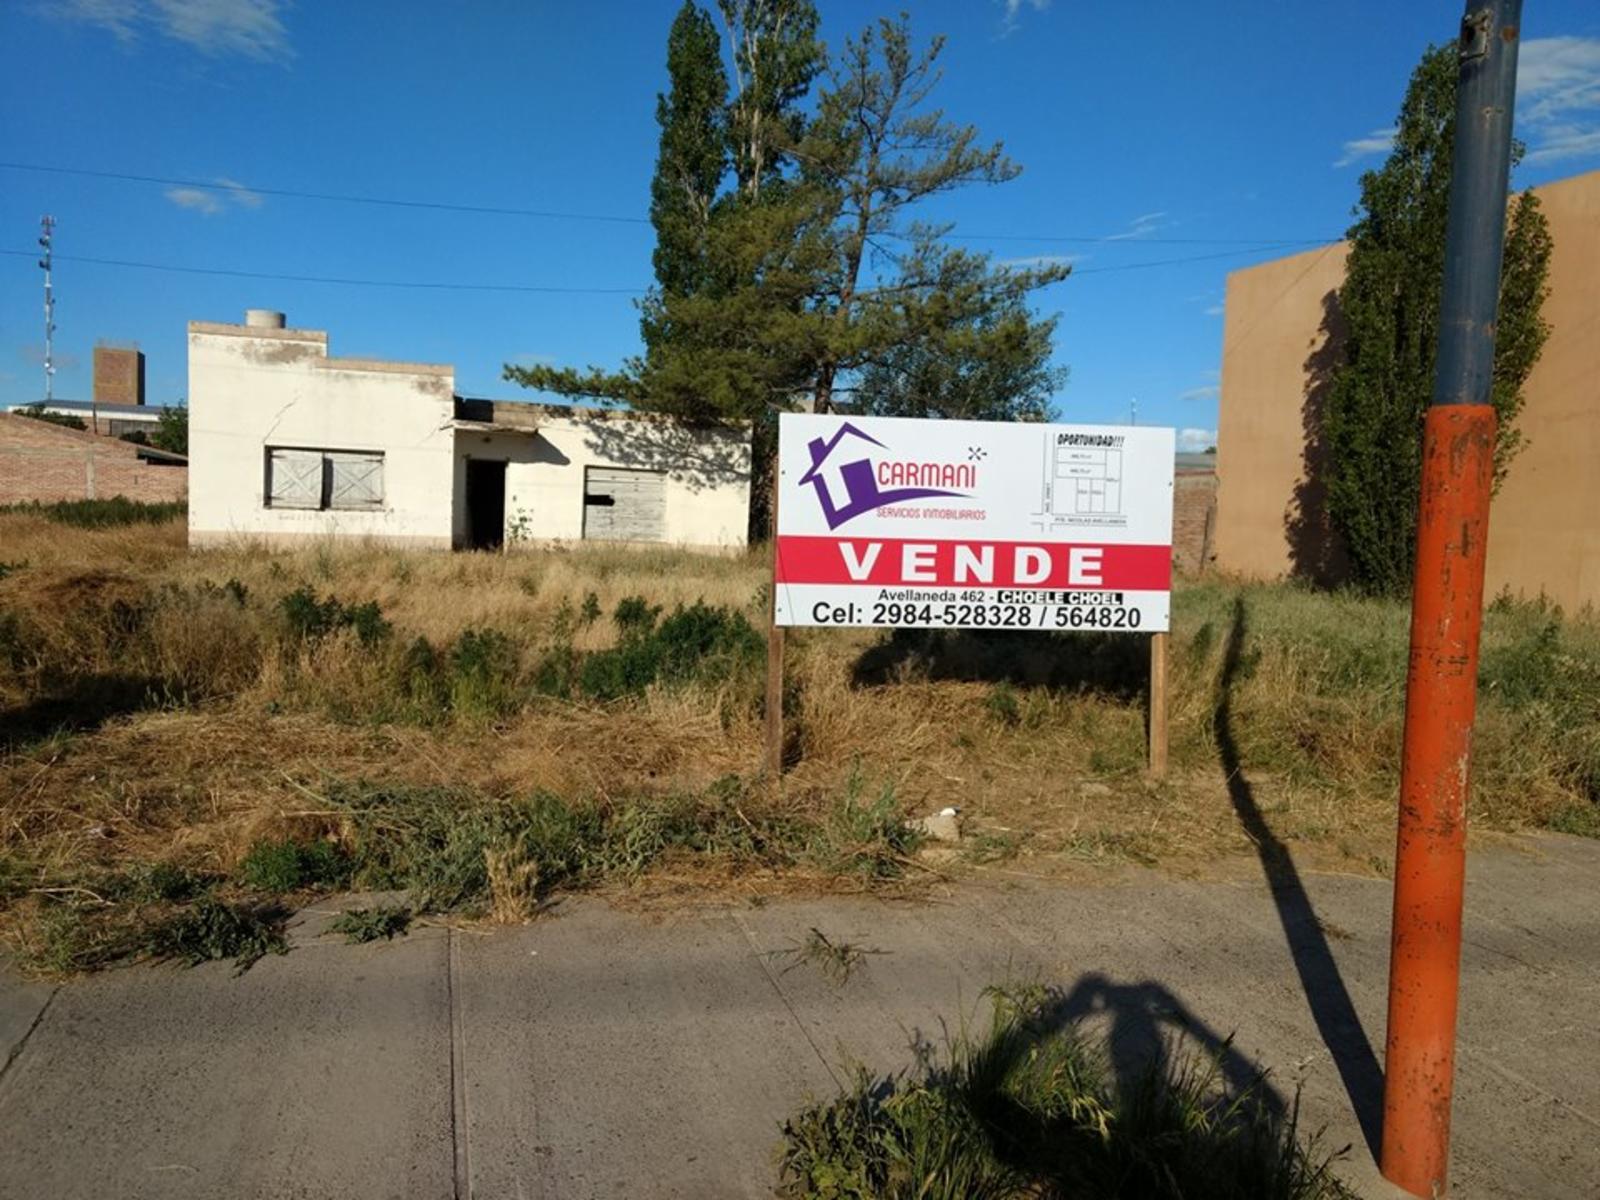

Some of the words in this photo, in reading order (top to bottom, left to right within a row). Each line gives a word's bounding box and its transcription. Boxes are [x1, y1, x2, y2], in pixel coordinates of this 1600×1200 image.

[1057, 433, 1125, 447] OPORTUNIDAD!!!
[877, 461, 976, 488] CARMANI
[877, 508, 921, 519] SERVICIOS
[838, 542, 1104, 586] VENDE
[878, 589, 956, 602] Avellaneda
[960, 590, 985, 602] 462
[1000, 591, 1064, 604] CHOELE
[1068, 592, 1121, 604] CHOEL
[812, 601, 863, 624] Cel:
[873, 604, 1032, 626] 2984-528328
[1038, 605, 1047, 627] /
[1055, 606, 1142, 628] 564820
